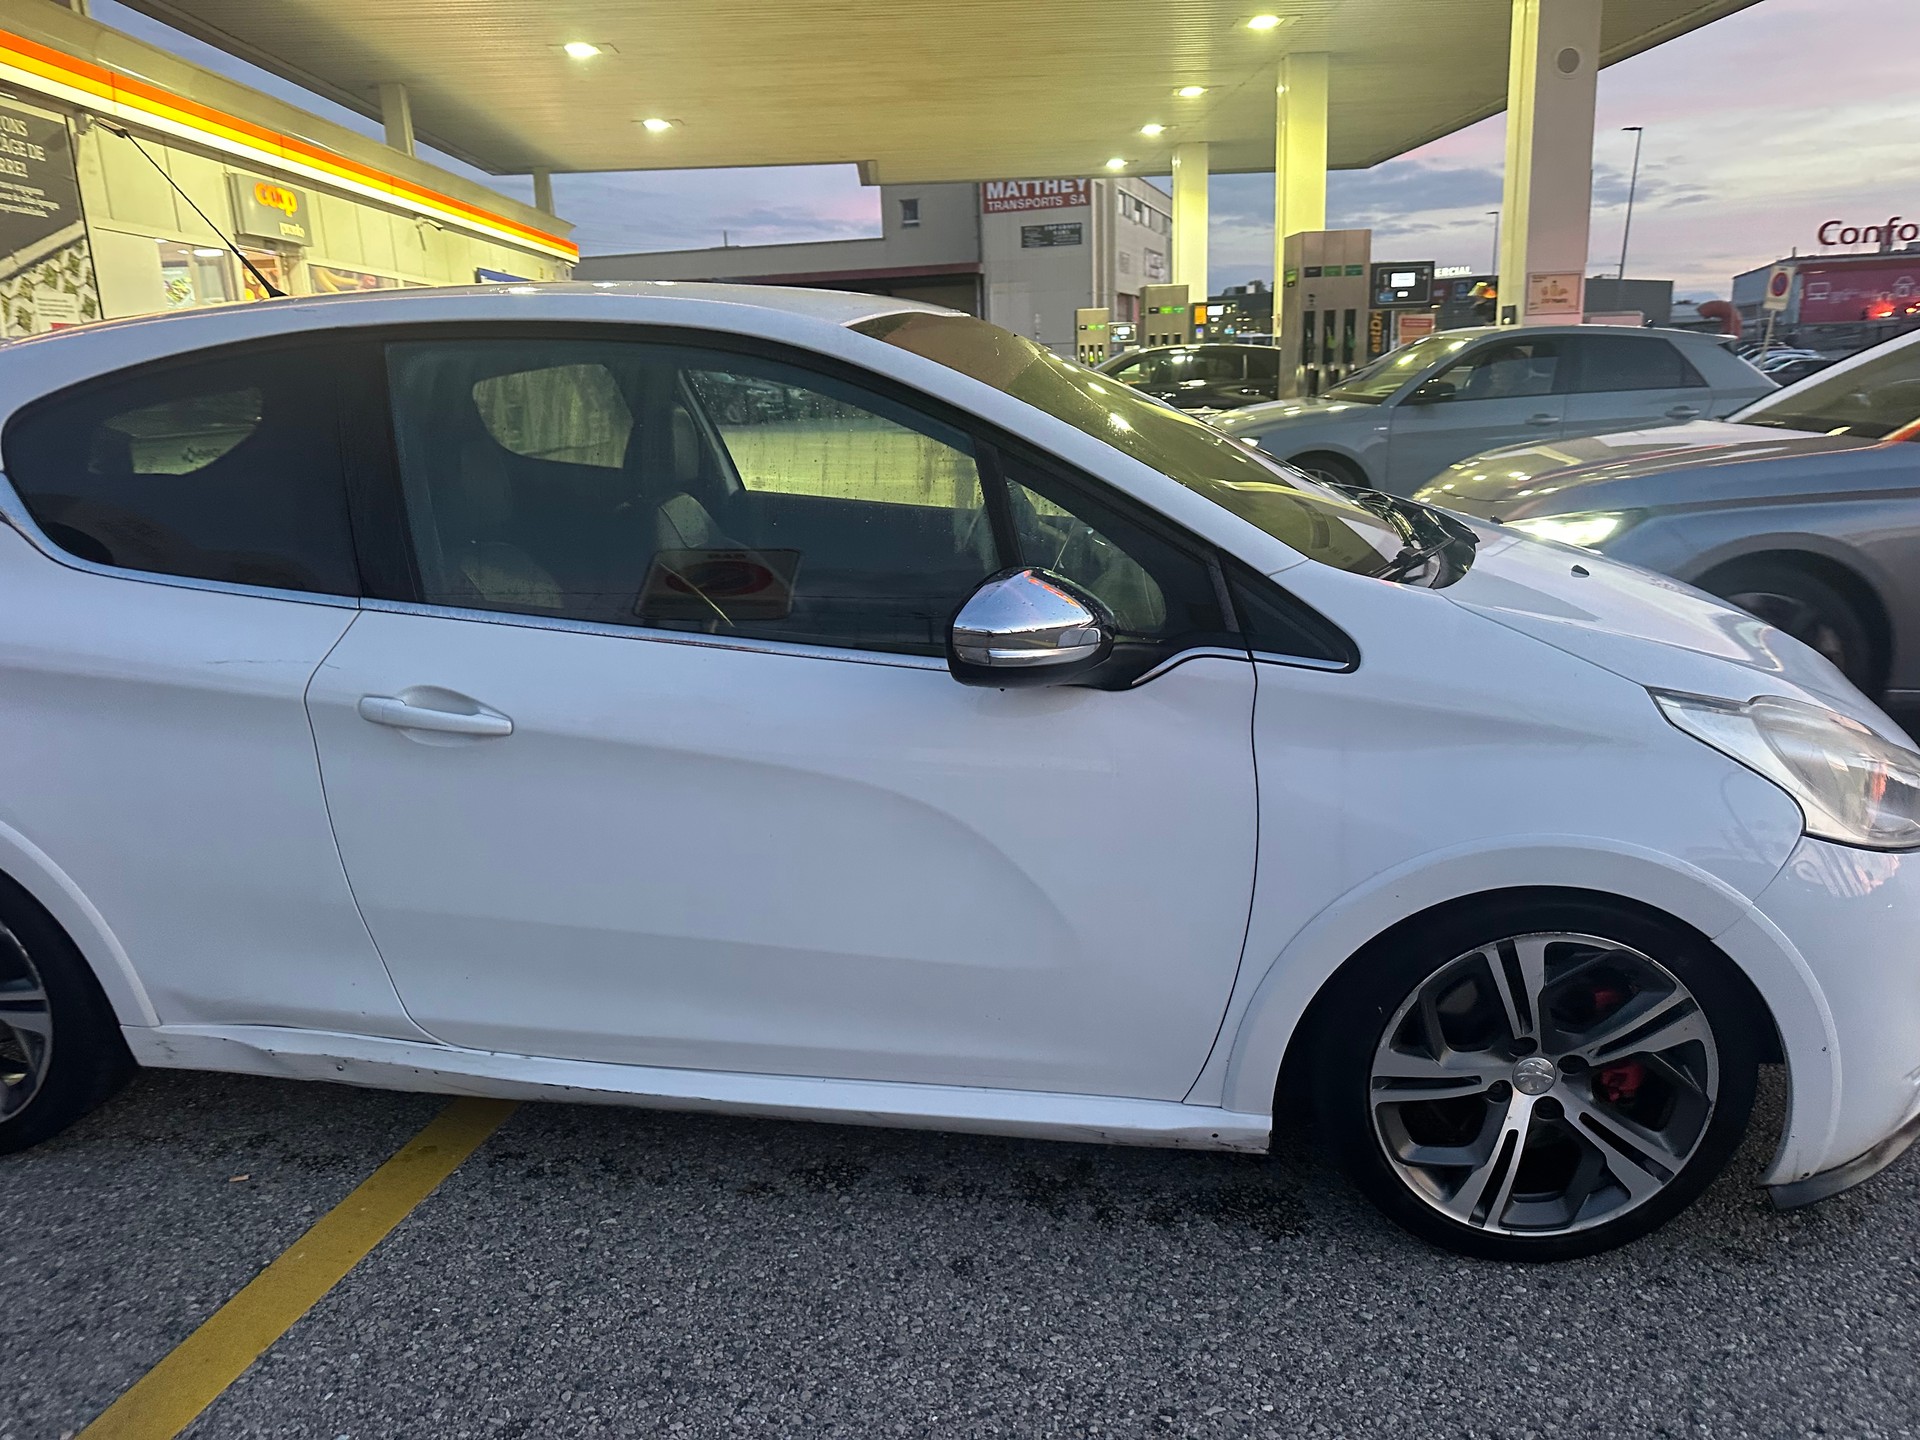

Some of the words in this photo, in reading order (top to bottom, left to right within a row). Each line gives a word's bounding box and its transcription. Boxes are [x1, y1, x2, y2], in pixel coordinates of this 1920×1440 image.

[255, 182, 298, 217] coop
[986, 178, 1087, 199] MATTHEY
[988, 196, 1063, 212] TRANSPORTS
[1069, 194, 1087, 205] SA
[1818, 216, 1919, 246] Confo
